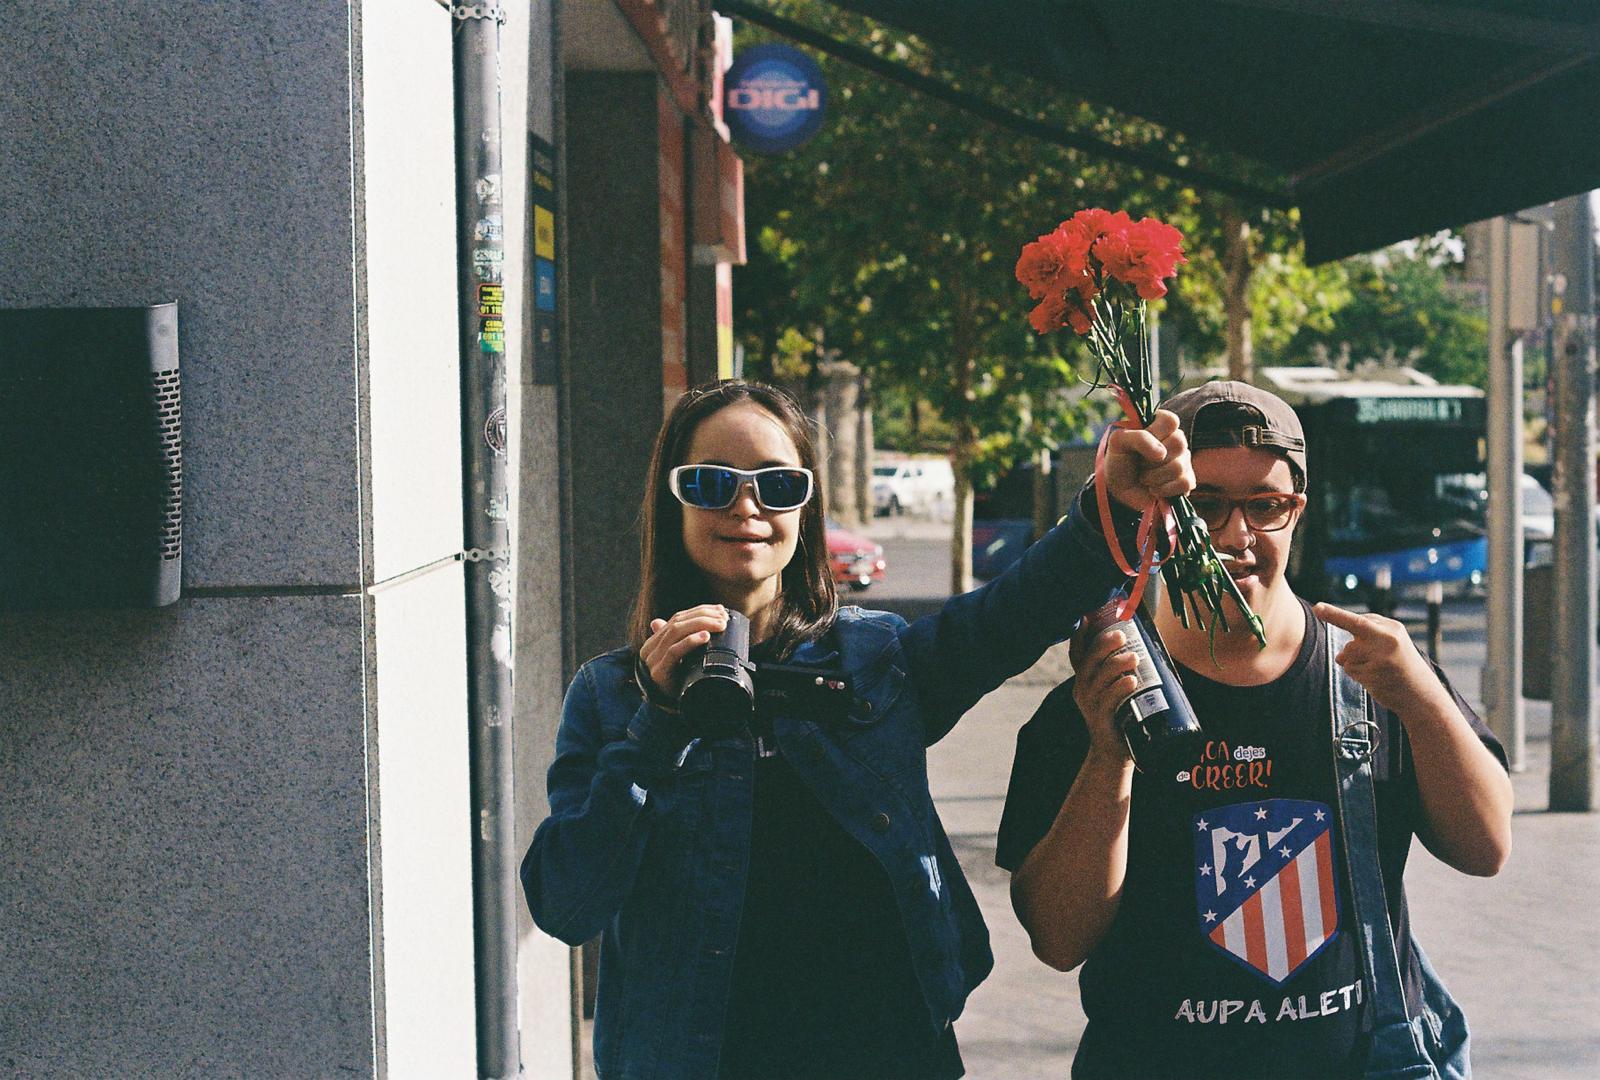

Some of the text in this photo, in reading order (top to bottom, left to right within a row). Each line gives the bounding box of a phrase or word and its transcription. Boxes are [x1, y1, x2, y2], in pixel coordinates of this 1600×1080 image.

[728, 88, 819, 110] DIGI
[1234, 746, 1266, 762] dejes
[1177, 759, 1273, 791] de CREER!
[1173, 979, 1363, 1024] AUPA ALETI
